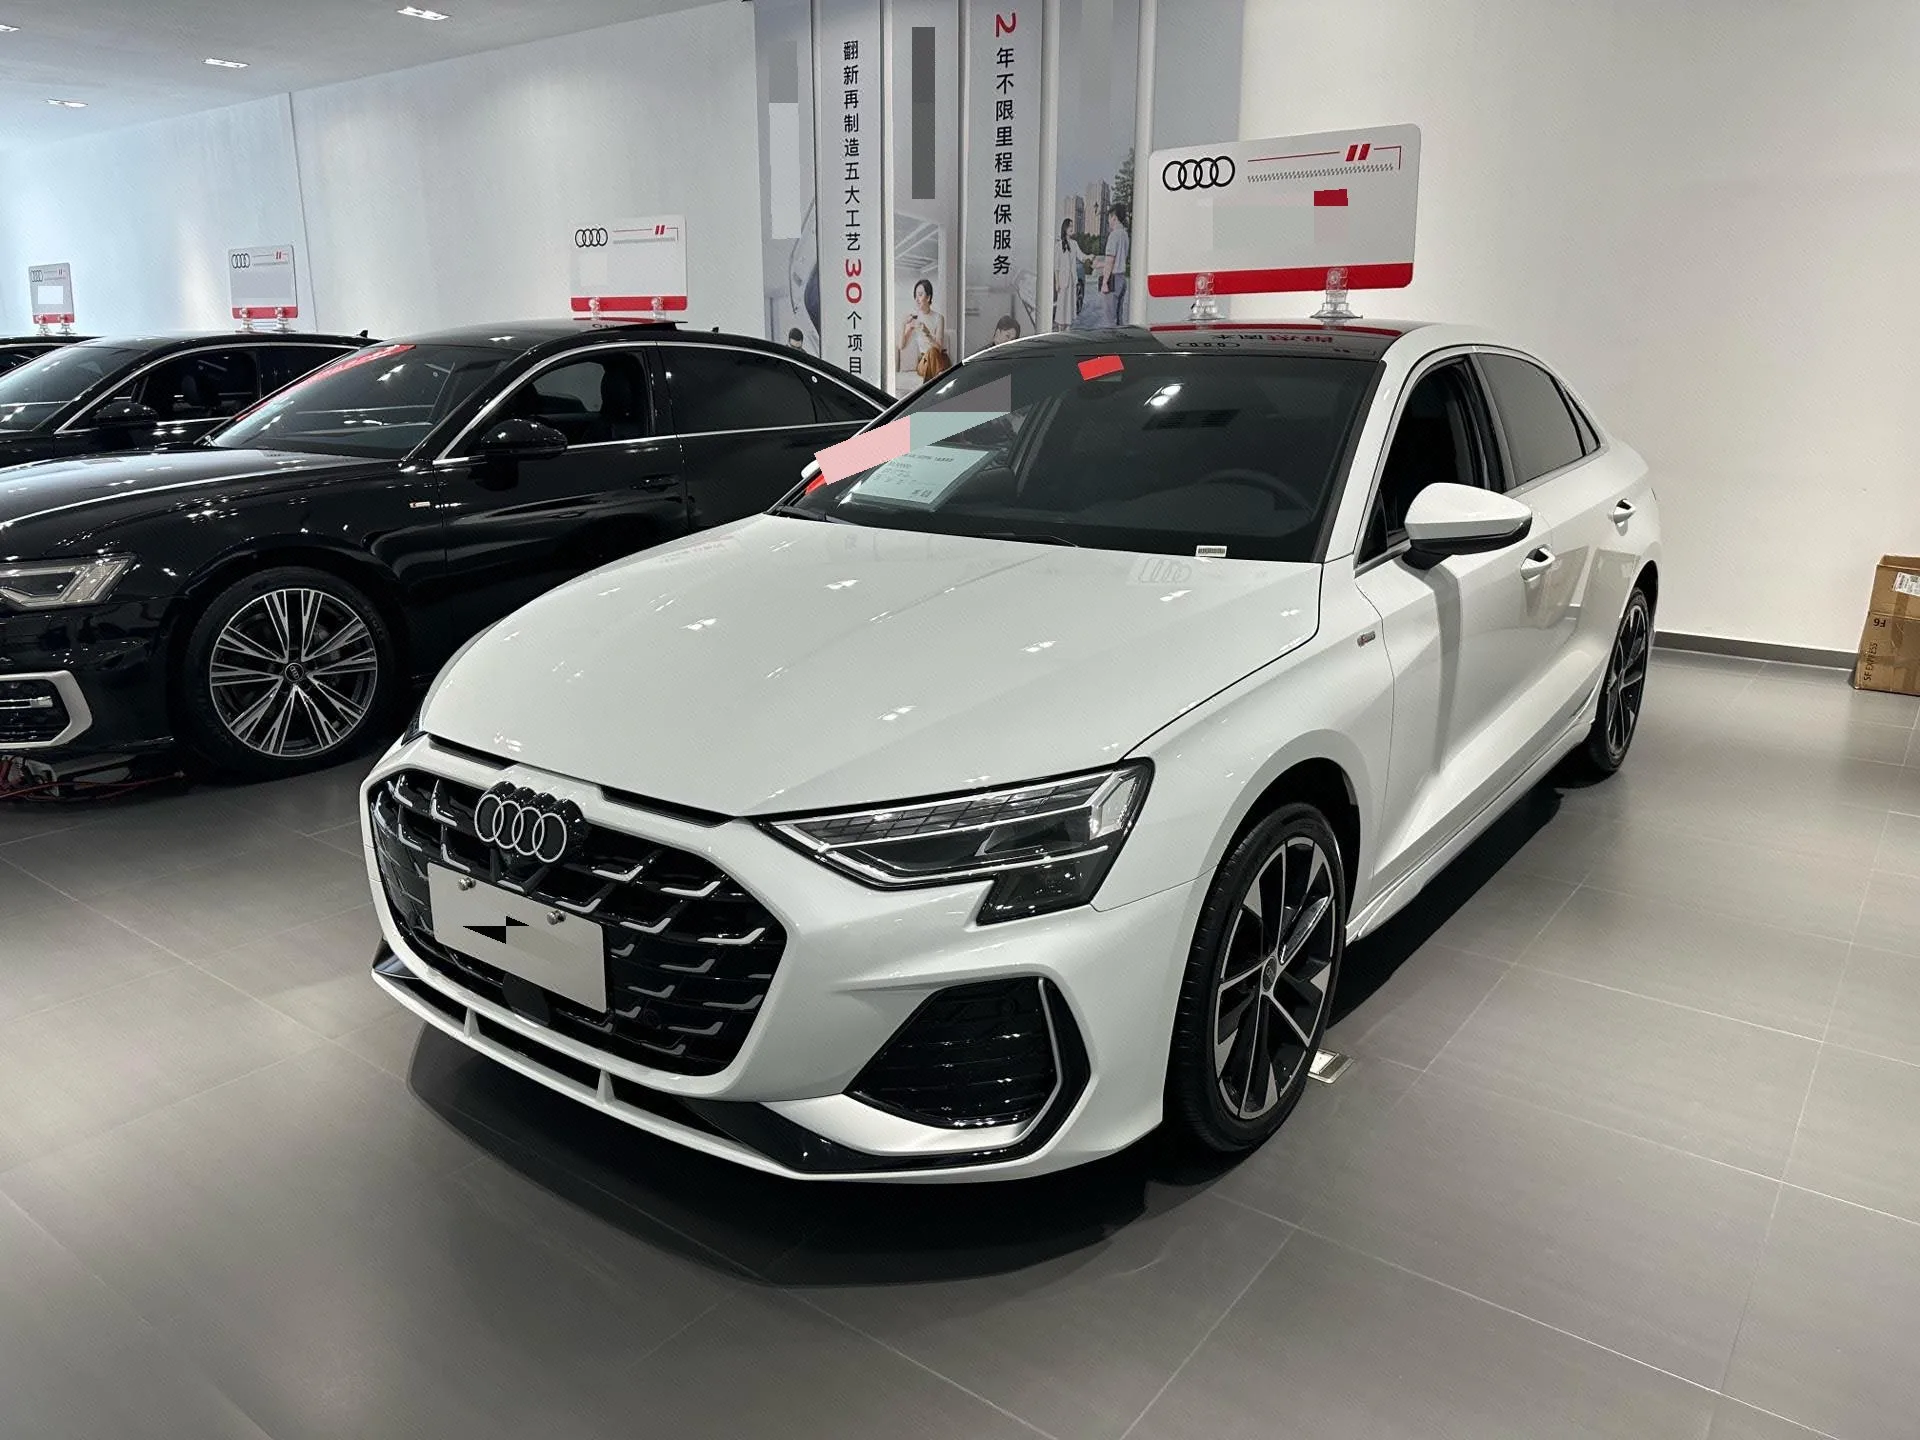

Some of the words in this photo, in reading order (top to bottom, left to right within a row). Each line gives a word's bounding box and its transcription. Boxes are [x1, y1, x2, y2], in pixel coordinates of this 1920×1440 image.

[843, 40, 863, 374] 翻新再制造五大工艺30个项目
[992, 12, 1017, 276] 2年不限里程延保服务
